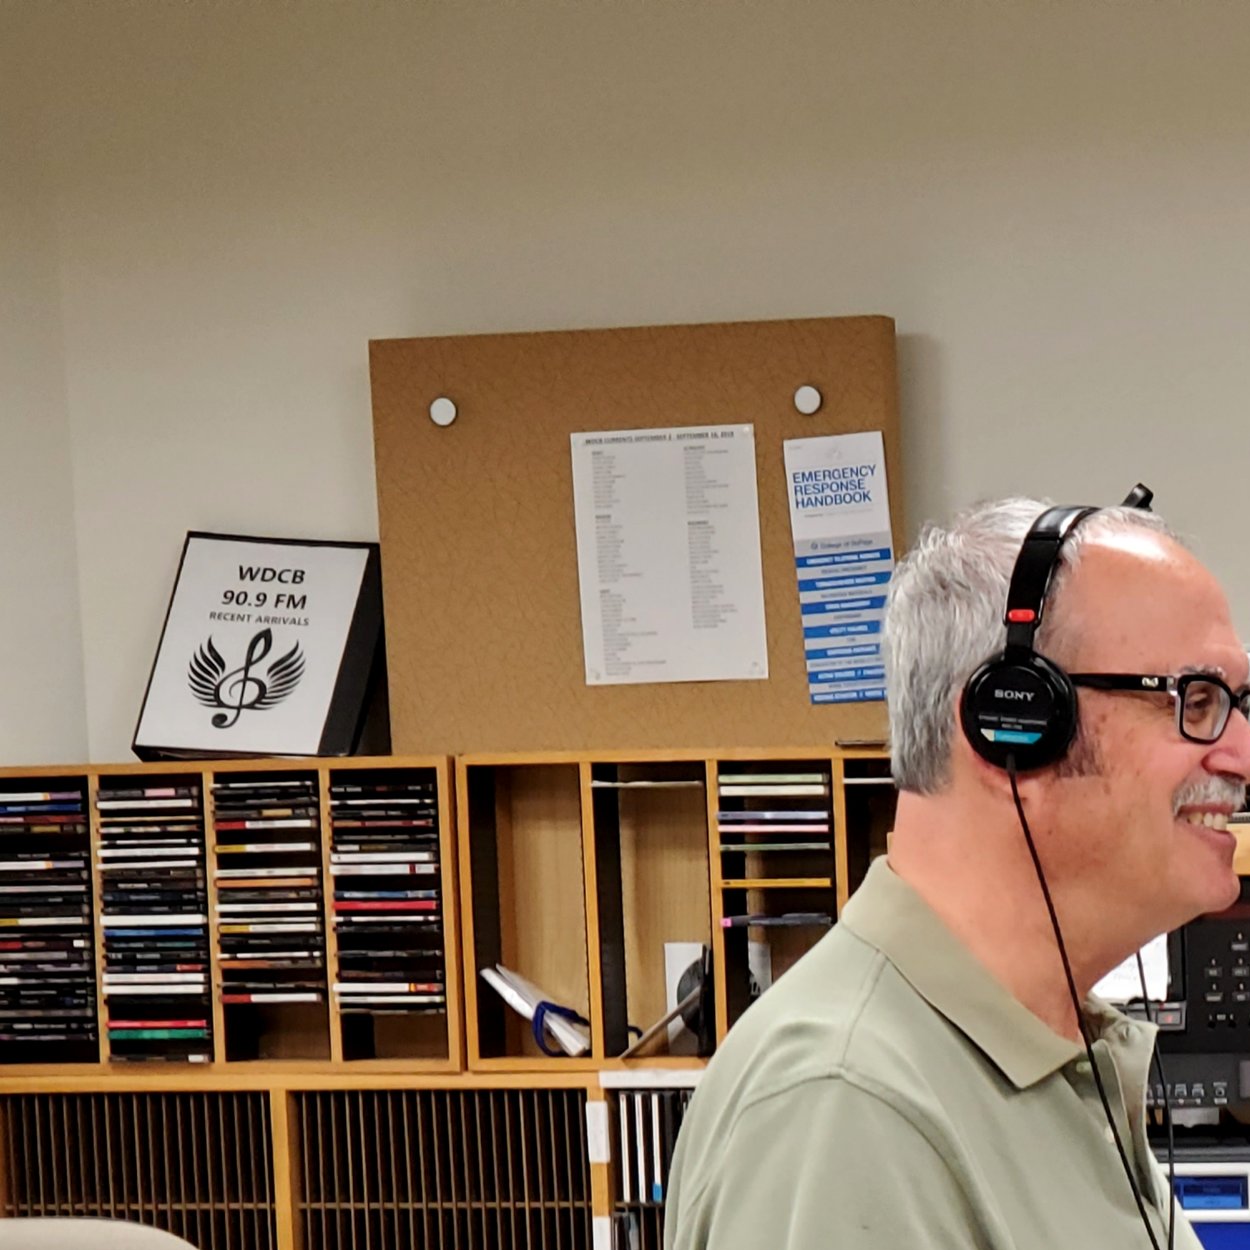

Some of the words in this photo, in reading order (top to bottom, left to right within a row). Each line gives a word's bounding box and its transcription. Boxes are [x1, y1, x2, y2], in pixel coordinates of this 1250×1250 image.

[792, 464, 876, 484] EMERGENCY
[793, 478, 866, 497] RESPONSE
[795, 490, 872, 510] HANDBOOK
[238, 565, 306, 585] WDCB
[221, 590, 268, 608] 90.9
[274, 593, 307, 610] FM
[209, 612, 252, 624] RECENT
[255, 615, 310, 626] ARRIVALS
[994, 688, 1034, 702] SONY
